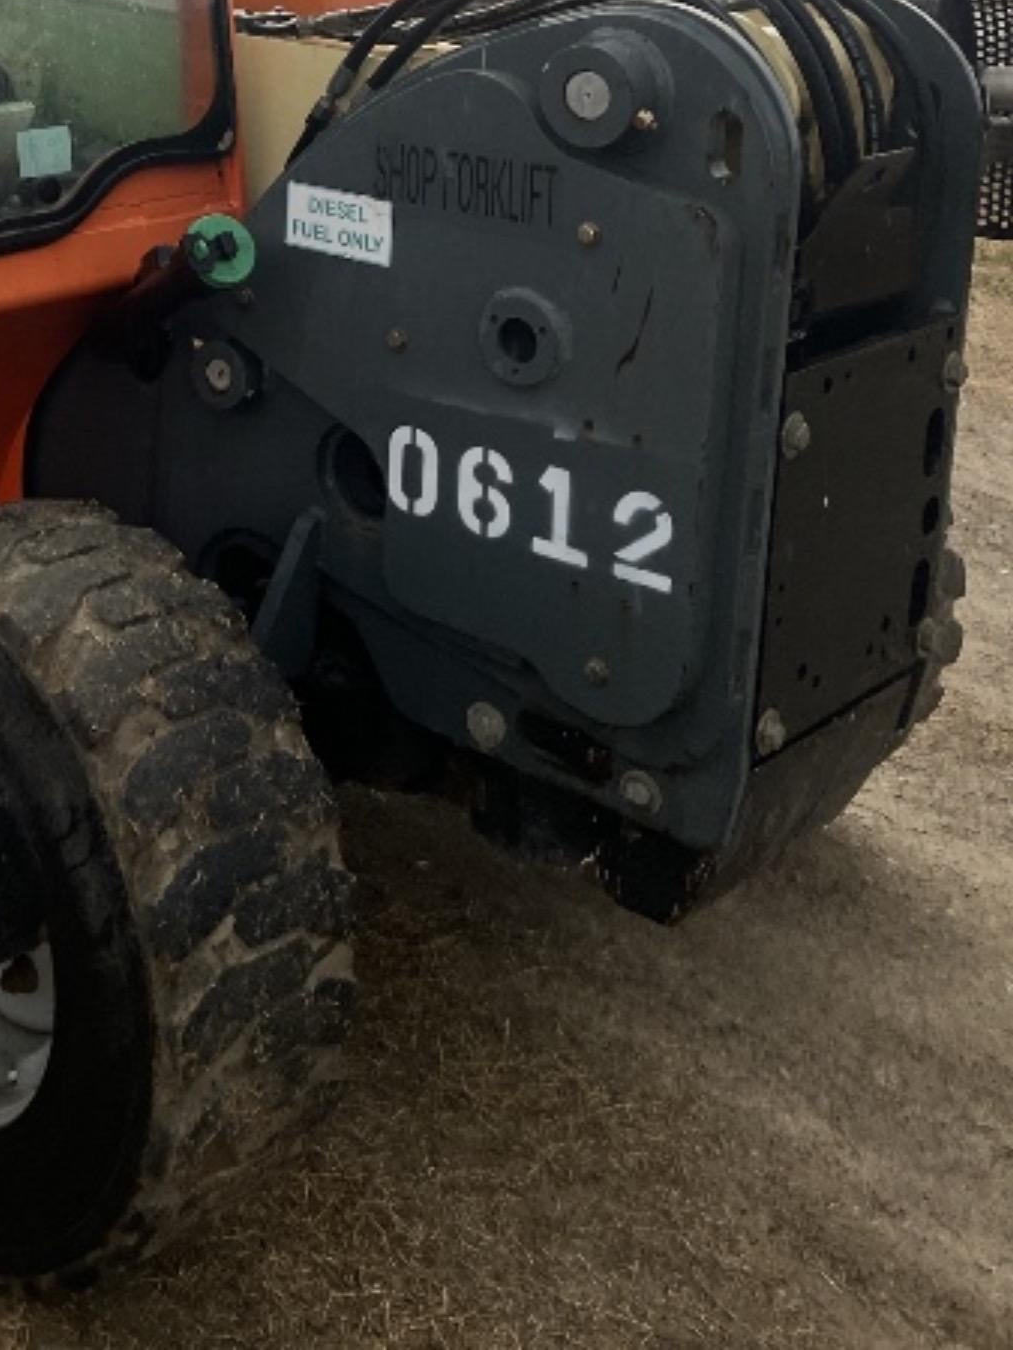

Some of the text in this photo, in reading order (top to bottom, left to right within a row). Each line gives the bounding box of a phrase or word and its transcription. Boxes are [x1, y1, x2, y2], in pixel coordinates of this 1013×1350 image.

[374, 144, 436, 206] SHOP
[308, 196, 368, 223] DIESEL
[292, 218, 385, 252] FUEL ONLY
[388, 425, 673, 595] 0612
